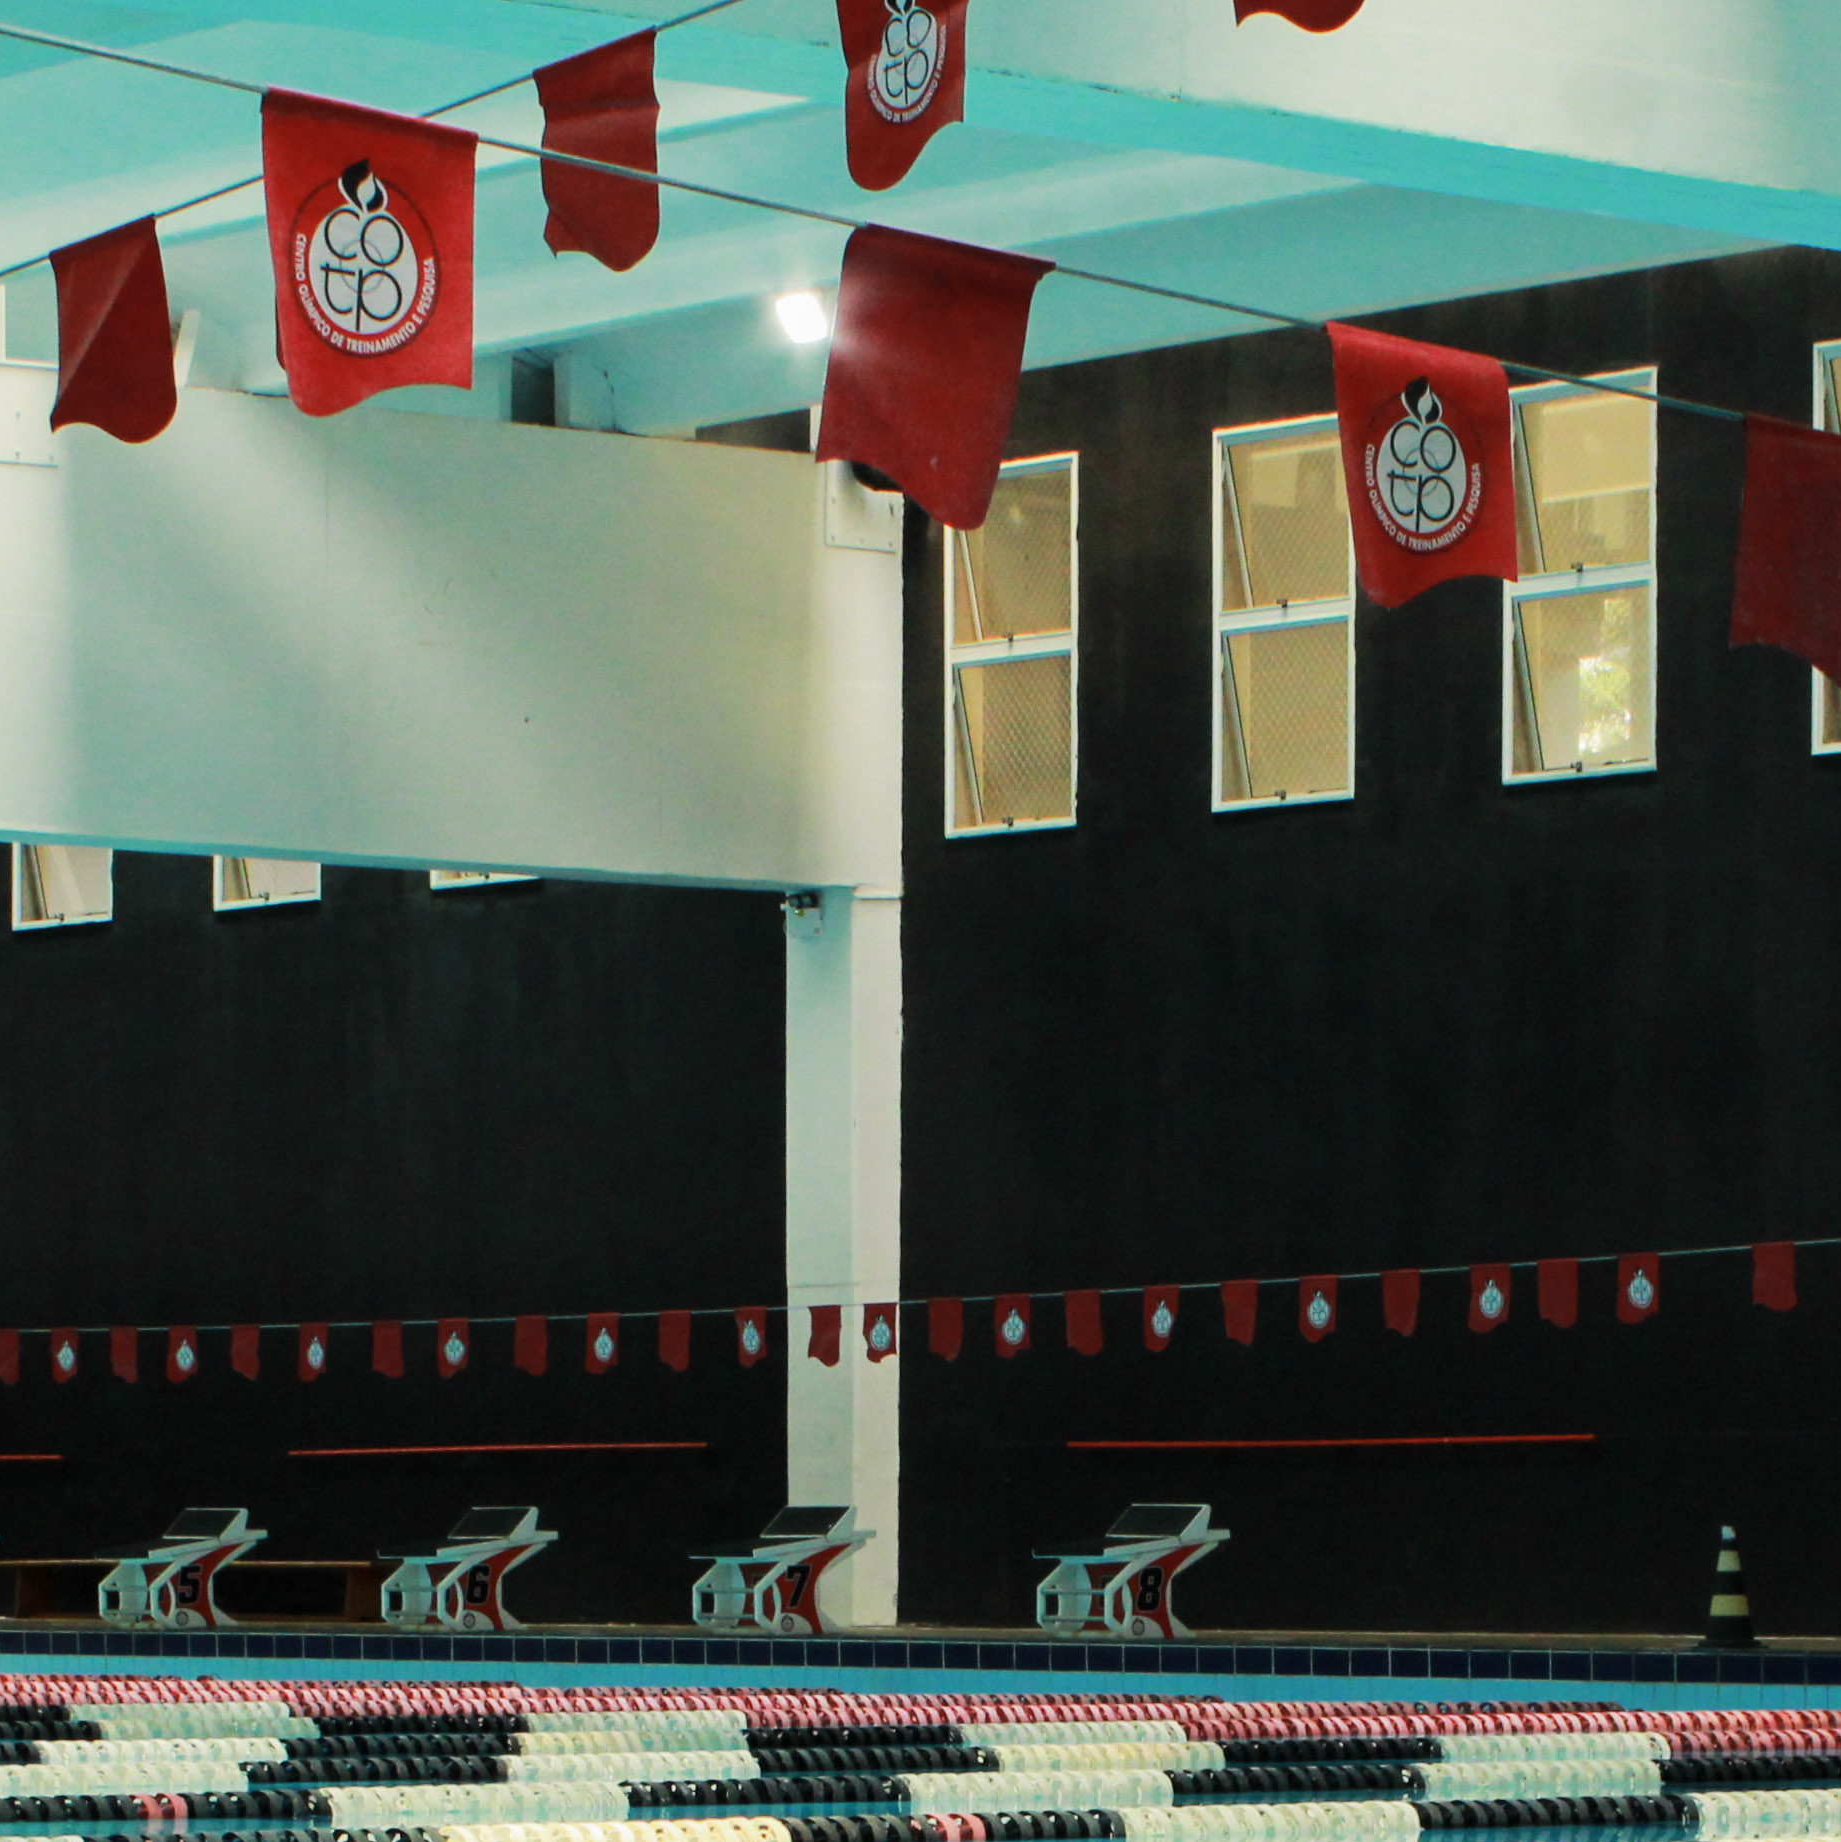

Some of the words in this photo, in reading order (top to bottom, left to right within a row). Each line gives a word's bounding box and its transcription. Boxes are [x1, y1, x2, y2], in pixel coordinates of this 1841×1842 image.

[294, 232, 307, 282] CENTRO
[418, 256, 436, 317] PESQUISA
[298, 284, 331, 338] OLÍMPICO
[411, 313, 424, 325] E
[330, 332, 344, 348] DE
[346, 321, 417, 355] TREINAMENTO
[1365, 443, 1376, 488] CENTRO
[1468, 463, 1482, 516] PESQUISA
[1368, 489, 1397, 537] OLÍMPICO
[1462, 514, 1472, 525] E
[1396, 531, 1408, 545] DE
[1408, 522, 1467, 551] TREINAMENTO
[177, 1564, 203, 1605] 5
[466, 1563, 492, 1605] 6
[786, 1564, 812, 1609] 7
[1137, 1566, 1164, 1613] 8
